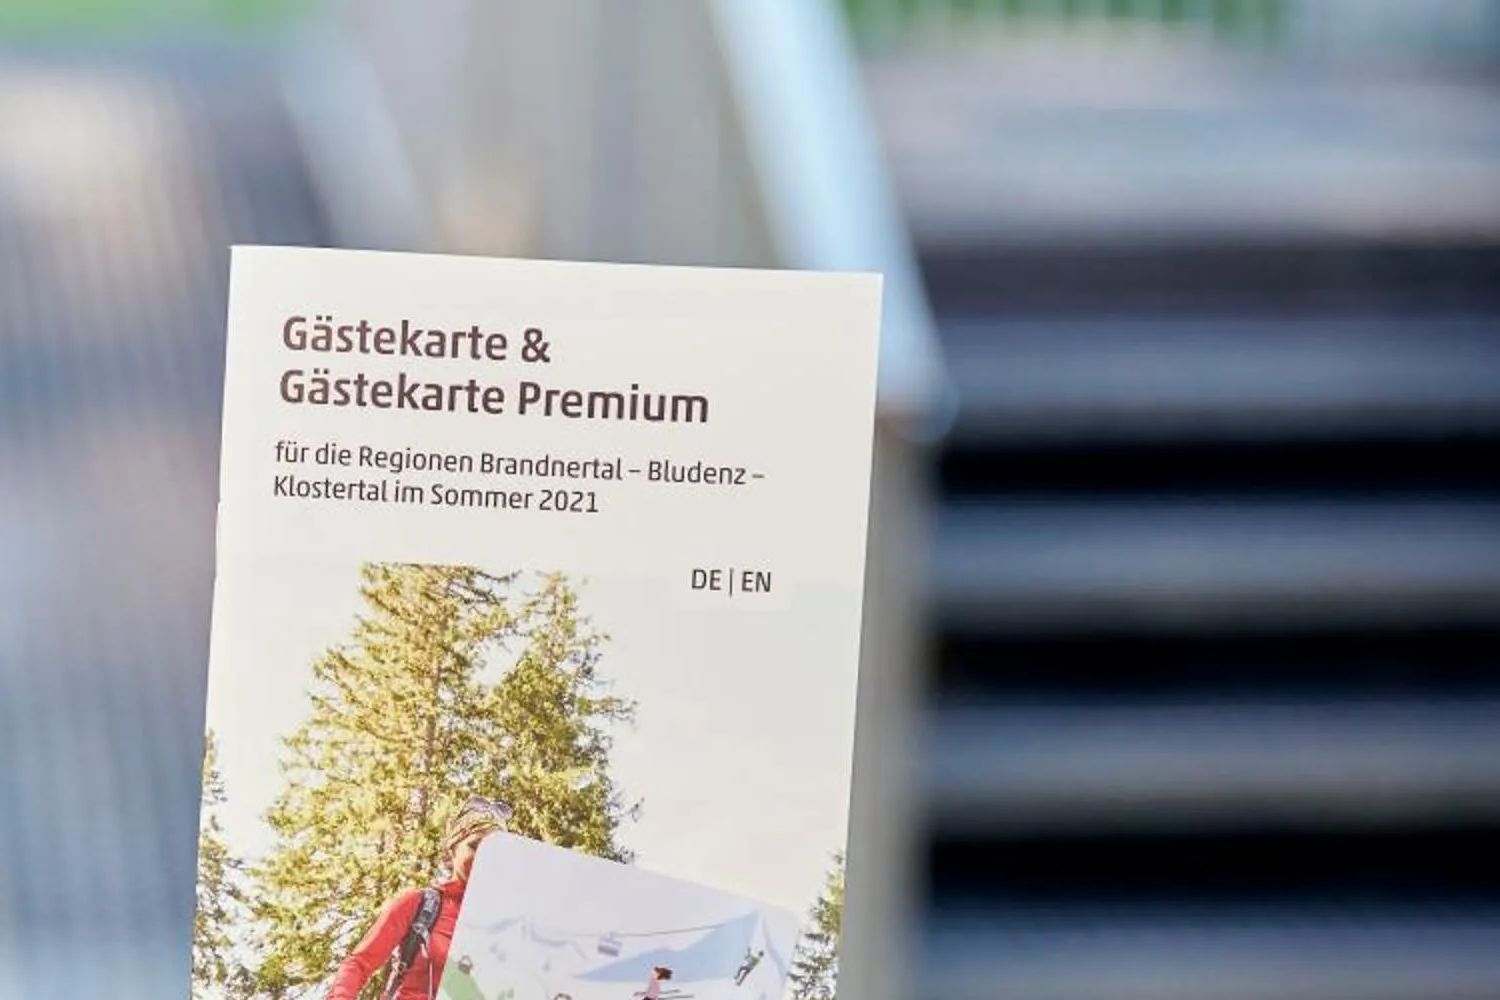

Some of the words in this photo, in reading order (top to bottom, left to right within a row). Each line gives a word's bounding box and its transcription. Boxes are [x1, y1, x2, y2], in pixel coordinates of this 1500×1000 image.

[283, 315, 508, 361] Gästekarte
[521, 328, 551, 363] &
[279, 368, 505, 414] Gästekarte
[518, 381, 709, 423] Premium
[276, 441, 309, 464] für
[315, 443, 351, 466] die
[359, 446, 473, 473] Regionen
[480, 453, 623, 480] Brandnertal
[647, 459, 746, 485] Bludenz
[273, 475, 387, 502] Klostertal
[394, 481, 423, 504] im
[431, 484, 534, 509] Sommer
[539, 489, 599, 513] 2021
[691, 568, 722, 590] DE
[741, 571, 772, 593] EN
